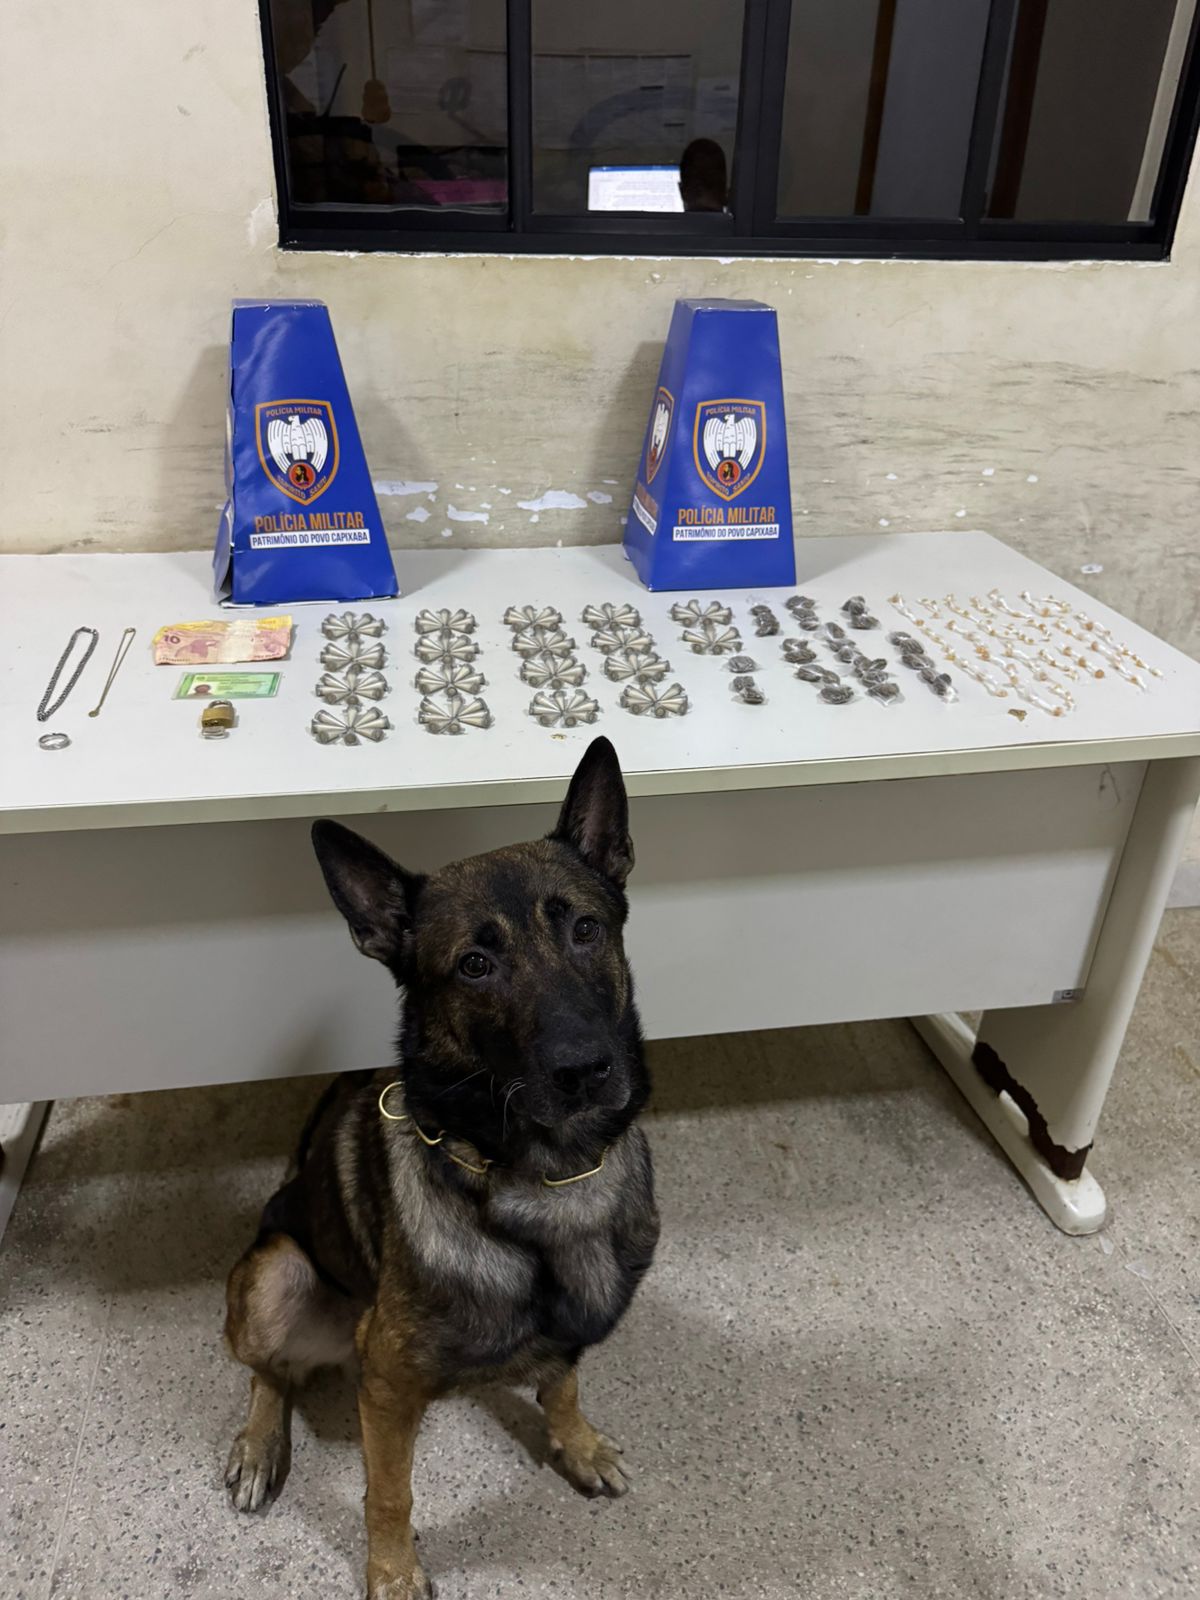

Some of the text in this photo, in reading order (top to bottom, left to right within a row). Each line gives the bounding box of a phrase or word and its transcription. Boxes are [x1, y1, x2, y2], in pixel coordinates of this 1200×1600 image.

[255, 511, 365, 533] POLÍCIA MILITAR
[678, 505, 775, 525] POLÍCIA MILITAR
[252, 531, 368, 546] PATRIMÔNIO DO POVO CAPIXABA
[675, 527, 777, 538] PATRIMÔNIO DO POVO CAPIXABA
